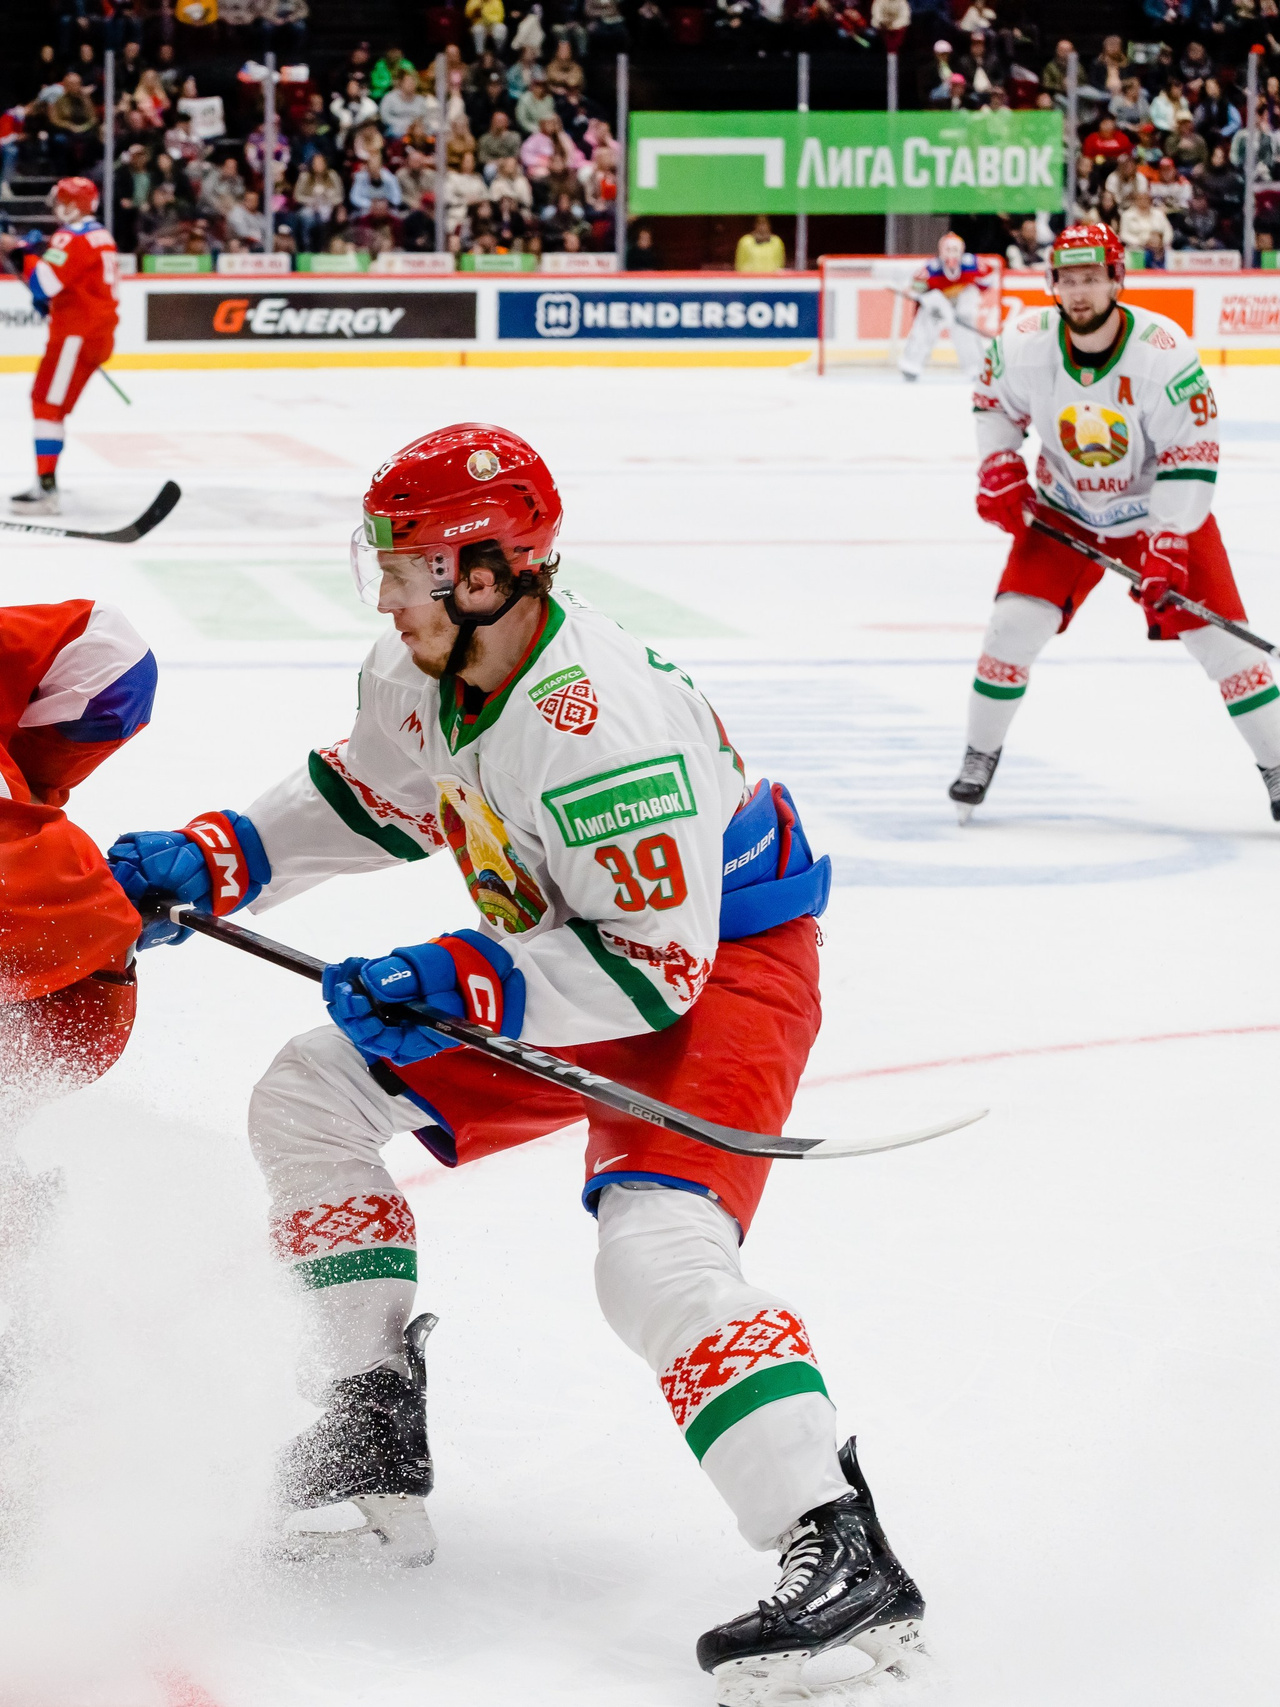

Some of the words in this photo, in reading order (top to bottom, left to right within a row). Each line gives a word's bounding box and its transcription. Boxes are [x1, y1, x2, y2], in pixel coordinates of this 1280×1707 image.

[583, 301, 799, 328] HENDERSON
[1117, 375, 1135, 406] A
[1189, 386, 1218, 427] 93
[1076, 475, 1134, 493] ELARU
[443, 517, 491, 538] CCM
[430, 590, 451, 598] CCM
[531, 668, 583, 699] БЕЛАРУСЬ
[594, 832, 688, 911] 39
[630, 1105, 665, 1126] CCM
[898, 1630, 920, 1645] TUK
